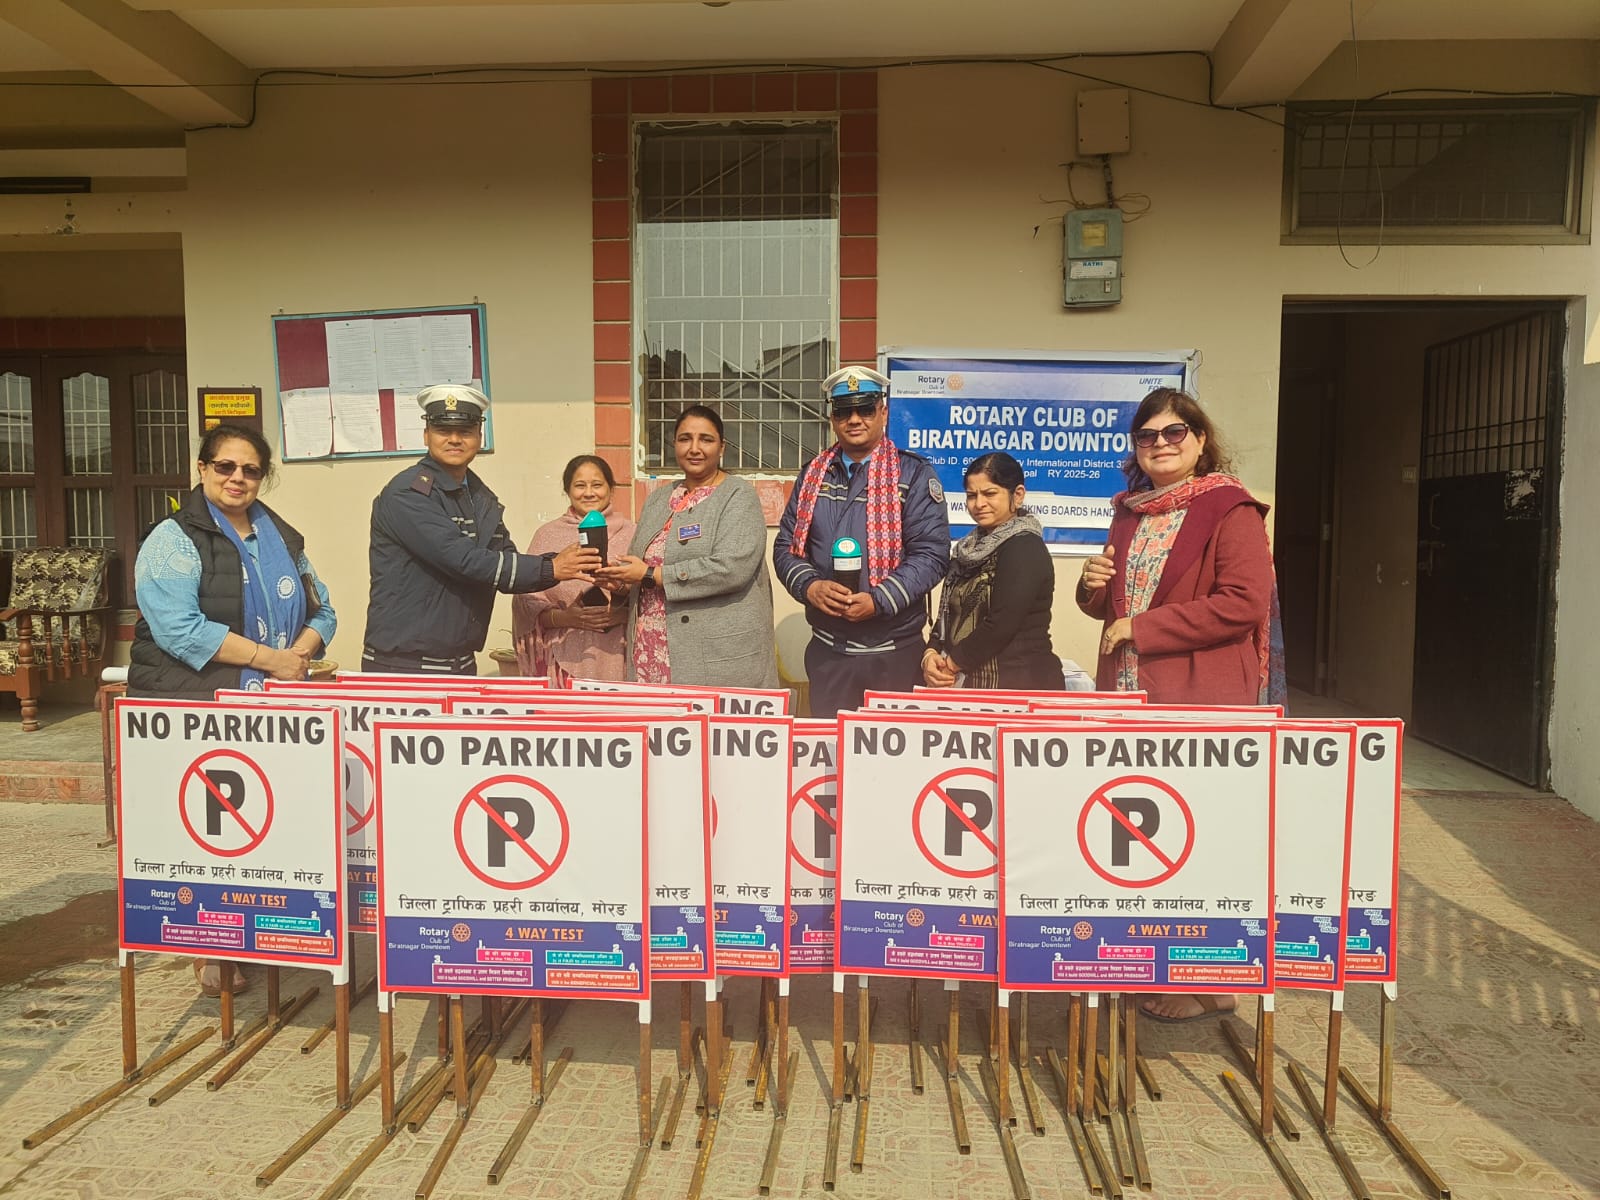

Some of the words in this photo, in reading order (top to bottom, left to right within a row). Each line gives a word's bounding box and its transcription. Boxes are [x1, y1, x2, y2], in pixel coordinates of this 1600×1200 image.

[918, 375, 945, 384] Rotary
[950, 405, 1028, 427] ROTARY
[1033, 407, 1086, 428] CLUB
[1092, 408, 1118, 428] OF
[908, 429, 1034, 450] BIRATNAGAR
[1026, 458, 1081, 468] International
[1083, 459, 1114, 468] District
[1048, 470, 1061, 478] RY
[1064, 470, 1101, 479] 2025-26
[950, 502, 968, 512] WAY
[1050, 506, 1088, 516] BOARDS
[127, 712, 170, 740] NO
[184, 713, 325, 746] PARKING
[853, 726, 906, 756] NO
[922, 729, 998, 760] PAR
[390, 736, 444, 766] NO
[461, 737, 632, 768] PARKING
[1014, 738, 1068, 768] NO
[1085, 738, 1260, 768] PARKING
[134, 858, 165, 874] जिल्ला
[169, 860, 206, 879] ट्राफिक
[210, 863, 236, 880] प्रहरी
[241, 866, 287, 884] कार्यालय,
[294, 867, 324, 885] मोरङ
[150, 889, 176, 900] Rotary
[222, 892, 228, 902] 4
[232, 892, 256, 905] WAY
[260, 894, 288, 906] TEST
[655, 883, 692, 900] मोरङ
[737, 882, 772, 899] मोरङ
[855, 878, 892, 897] जिल्ला
[898, 882, 942, 900] ट्राफिक
[948, 884, 977, 901] प्रहरी
[398, 894, 437, 912] जिल्ला
[442, 895, 487, 915] ट्राफिक
[492, 897, 522, 915] प्रहरी
[529, 898, 584, 917] कार्यालय,
[592, 898, 628, 917] मोरङ
[1020, 894, 1058, 911] जिल्ला
[1064, 895, 1110, 914] ट्राफिक
[1116, 896, 1146, 914] प्रहरी
[1152, 896, 1209, 914] कार्यालय,
[1216, 897, 1254, 914] मोरङ
[1290, 892, 1327, 910] मोरङ
[874, 910, 904, 922] Rotary
[958, 913, 968, 924] 4
[419, 926, 450, 938] Rotary
[505, 927, 514, 938] 4
[518, 928, 548, 940] WAY
[552, 928, 584, 940] TEST
[1040, 926, 1072, 936] Rotary
[1128, 924, 1136, 936] 4
[1141, 925, 1171, 936] WAY
[1176, 925, 1208, 936] TEST
[1008, 941, 1040, 949] Biratnagar
